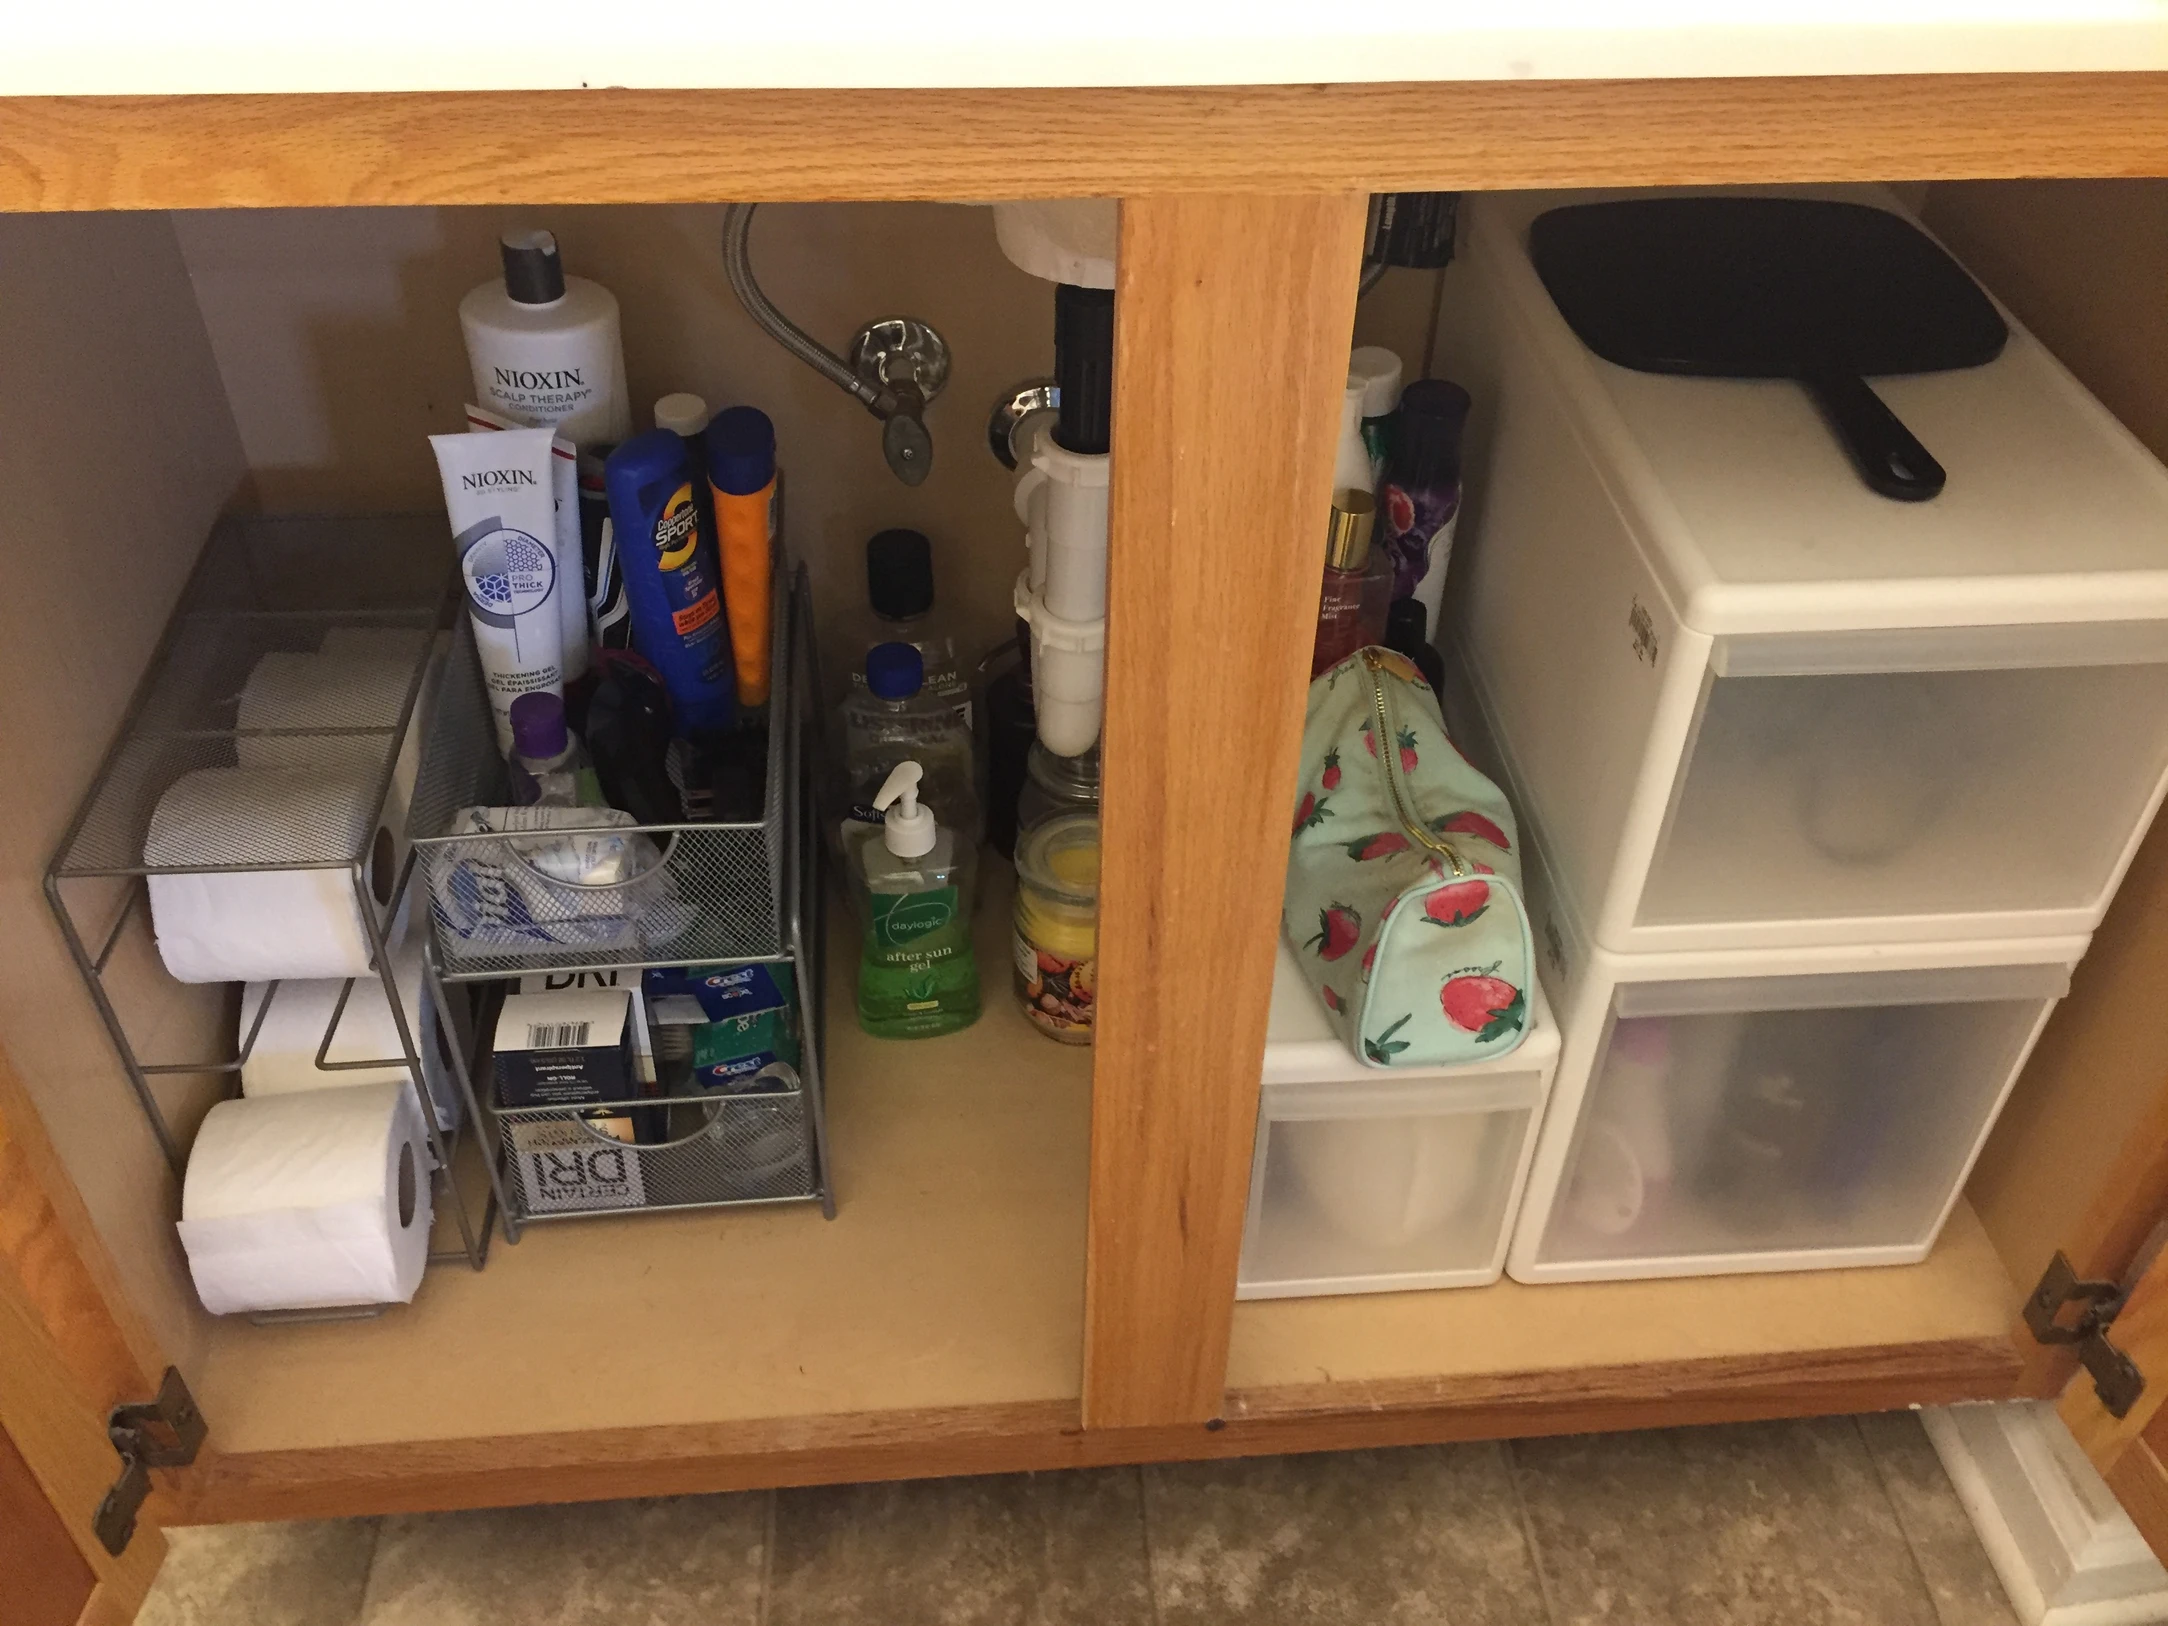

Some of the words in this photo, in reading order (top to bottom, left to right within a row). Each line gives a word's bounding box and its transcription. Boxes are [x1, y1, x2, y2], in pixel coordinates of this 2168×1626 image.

[494, 366, 582, 390] NIOXIN
[489, 386, 526, 403] SCALP
[508, 402, 574, 413] CONDITIONER
[462, 469, 534, 490] NIOXIN
[657, 503, 694, 531] Coppertone
[655, 509, 700, 547] SPORT
[517, 535, 546, 558] DIAMETER
[511, 573, 533, 582] PRO
[512, 581, 543, 589] THICK
[493, 669, 541, 679] THICKENING
[542, 665, 556, 674] GEL
[491, 678, 505, 686] GEL
[891, 916, 942, 931] daylogic
[886, 951, 922, 962] after
[925, 946, 953, 959] sun
[909, 959, 932, 973] gel
[531, 1149, 627, 1187] DRI
[538, 1184, 629, 1201] CERTAIN
